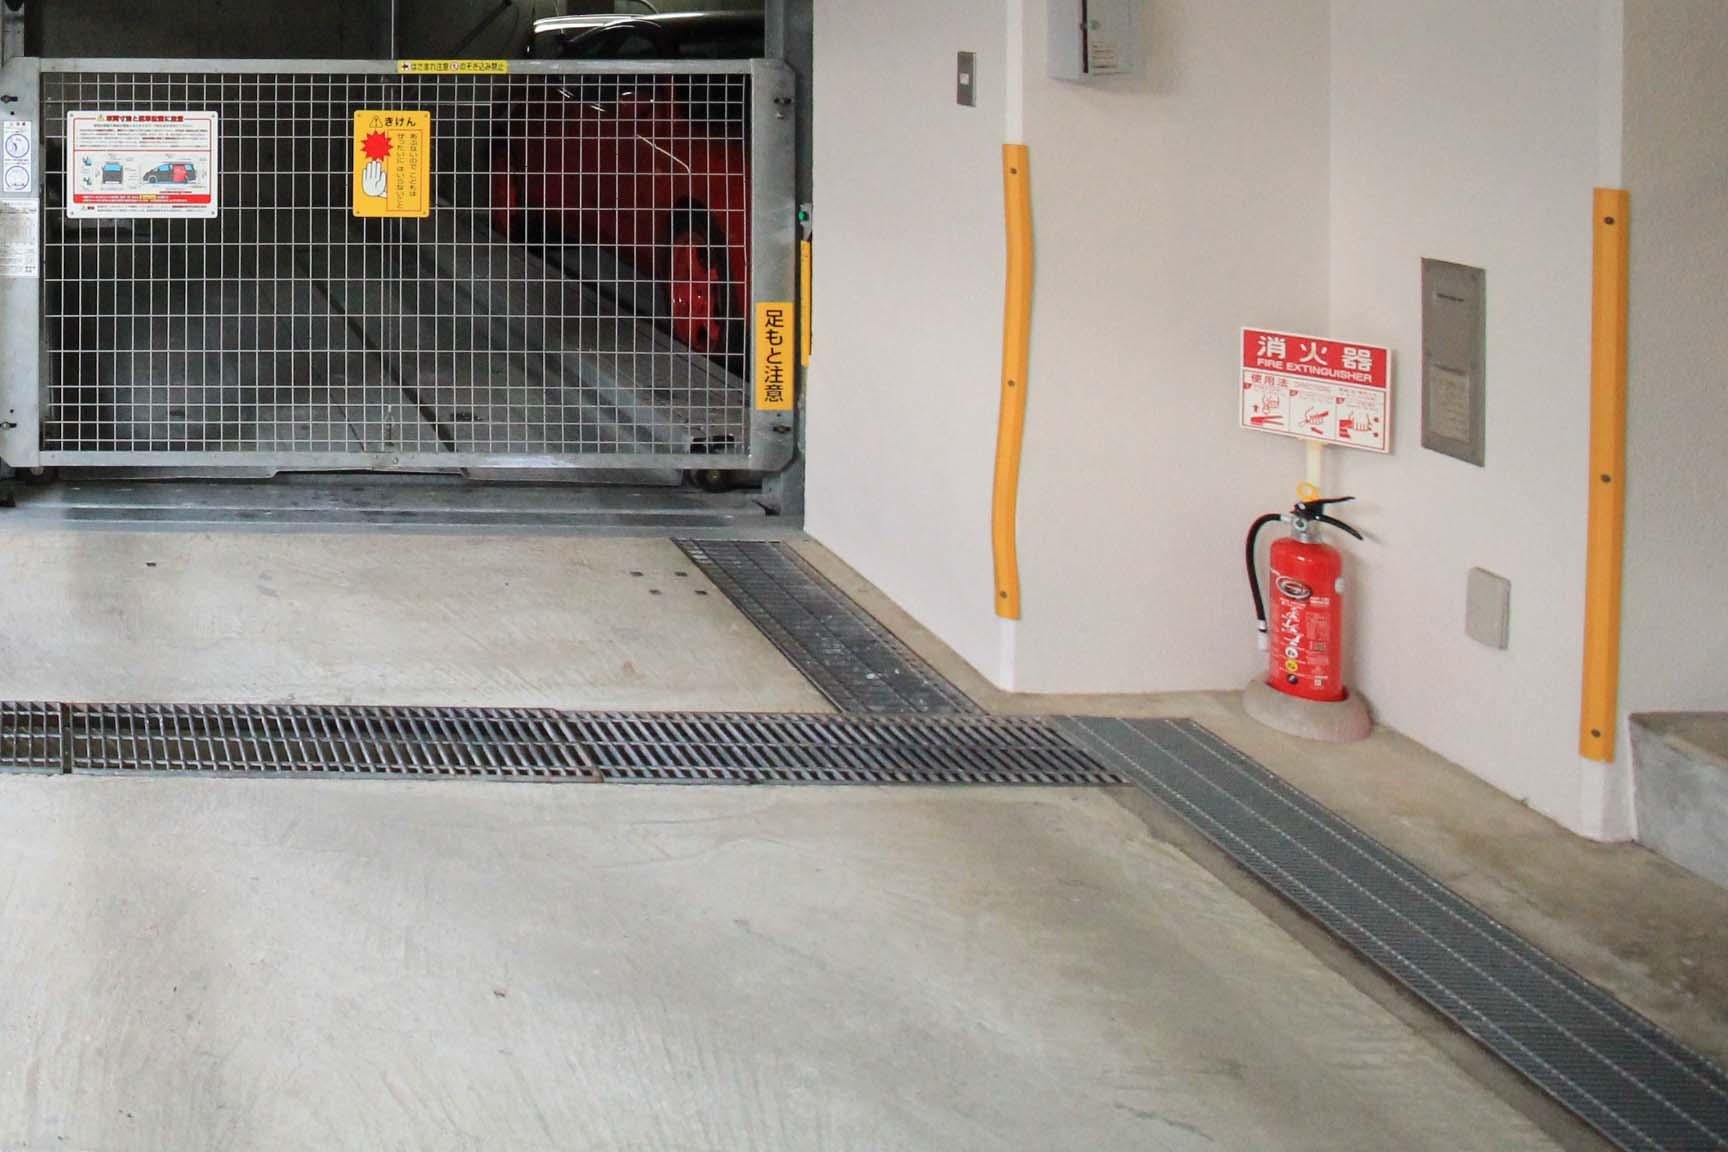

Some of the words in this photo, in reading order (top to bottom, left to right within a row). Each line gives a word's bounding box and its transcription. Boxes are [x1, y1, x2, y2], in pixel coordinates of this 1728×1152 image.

[385, 117, 416, 127] きけん
[764, 309, 785, 403] 足もと注意
[1256, 335, 1373, 372] 消火器
[1250, 373, 1289, 388] 使用法
[1256, 357, 1284, 370] FIRE
[1286, 361, 1373, 383] EXTINGUISHER
